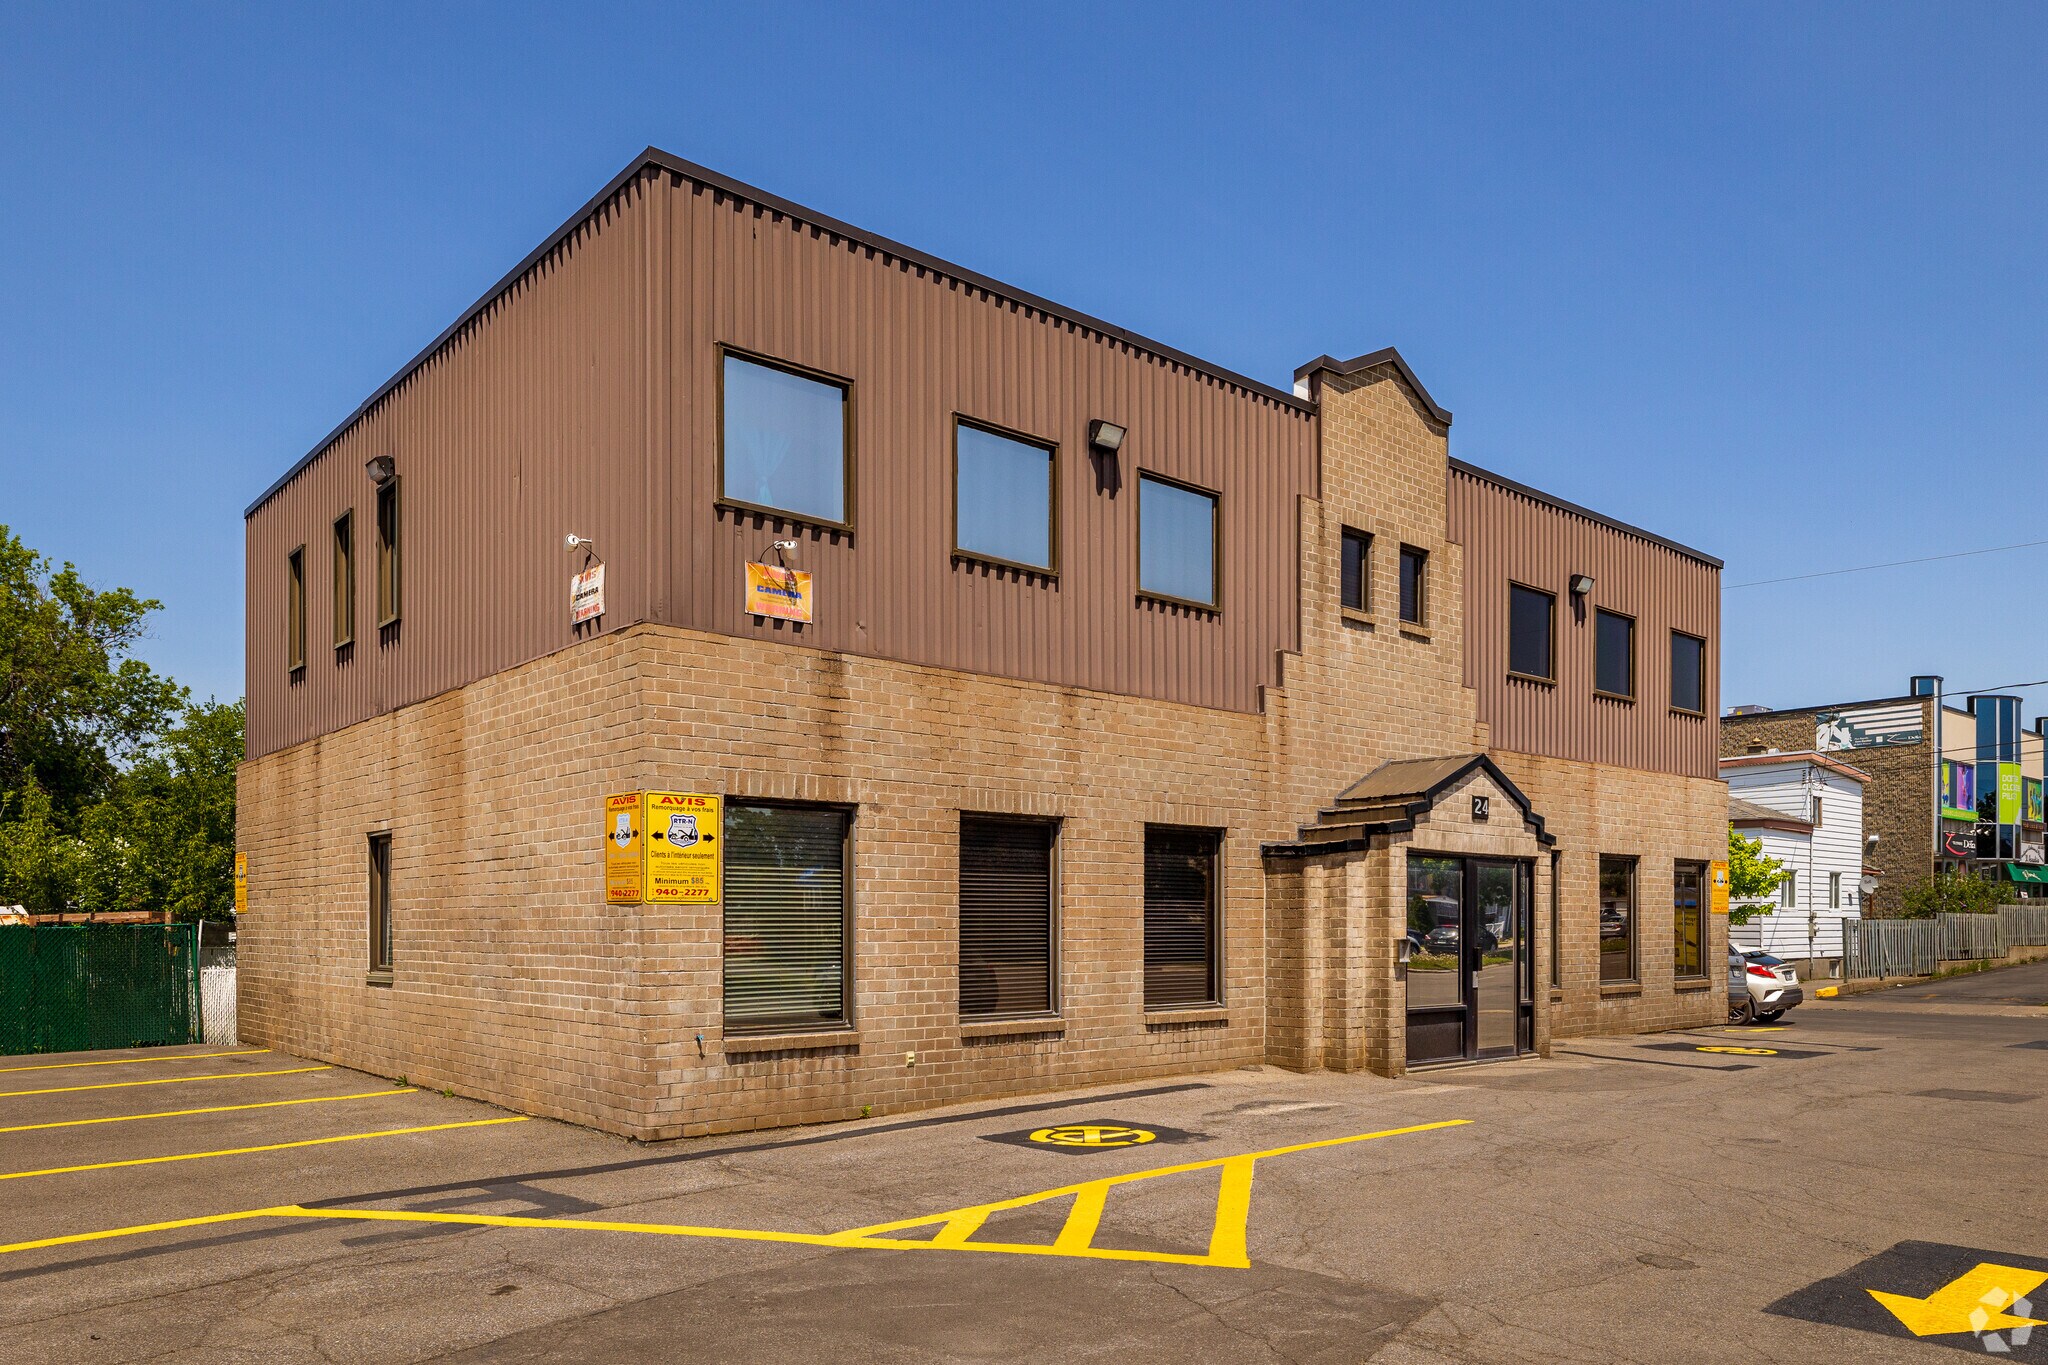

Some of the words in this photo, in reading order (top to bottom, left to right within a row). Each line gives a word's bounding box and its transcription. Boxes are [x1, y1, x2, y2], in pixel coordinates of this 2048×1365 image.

[576, 586, 599, 601] CAMERA
[757, 585, 802, 599] CAMERA
[612, 796, 636, 805] AVIS
[661, 797, 706, 806] AVIS
[652, 804, 686, 812] Remorquage
[1474, 798, 1488, 815] 24
[651, 850, 666, 858] Clients
